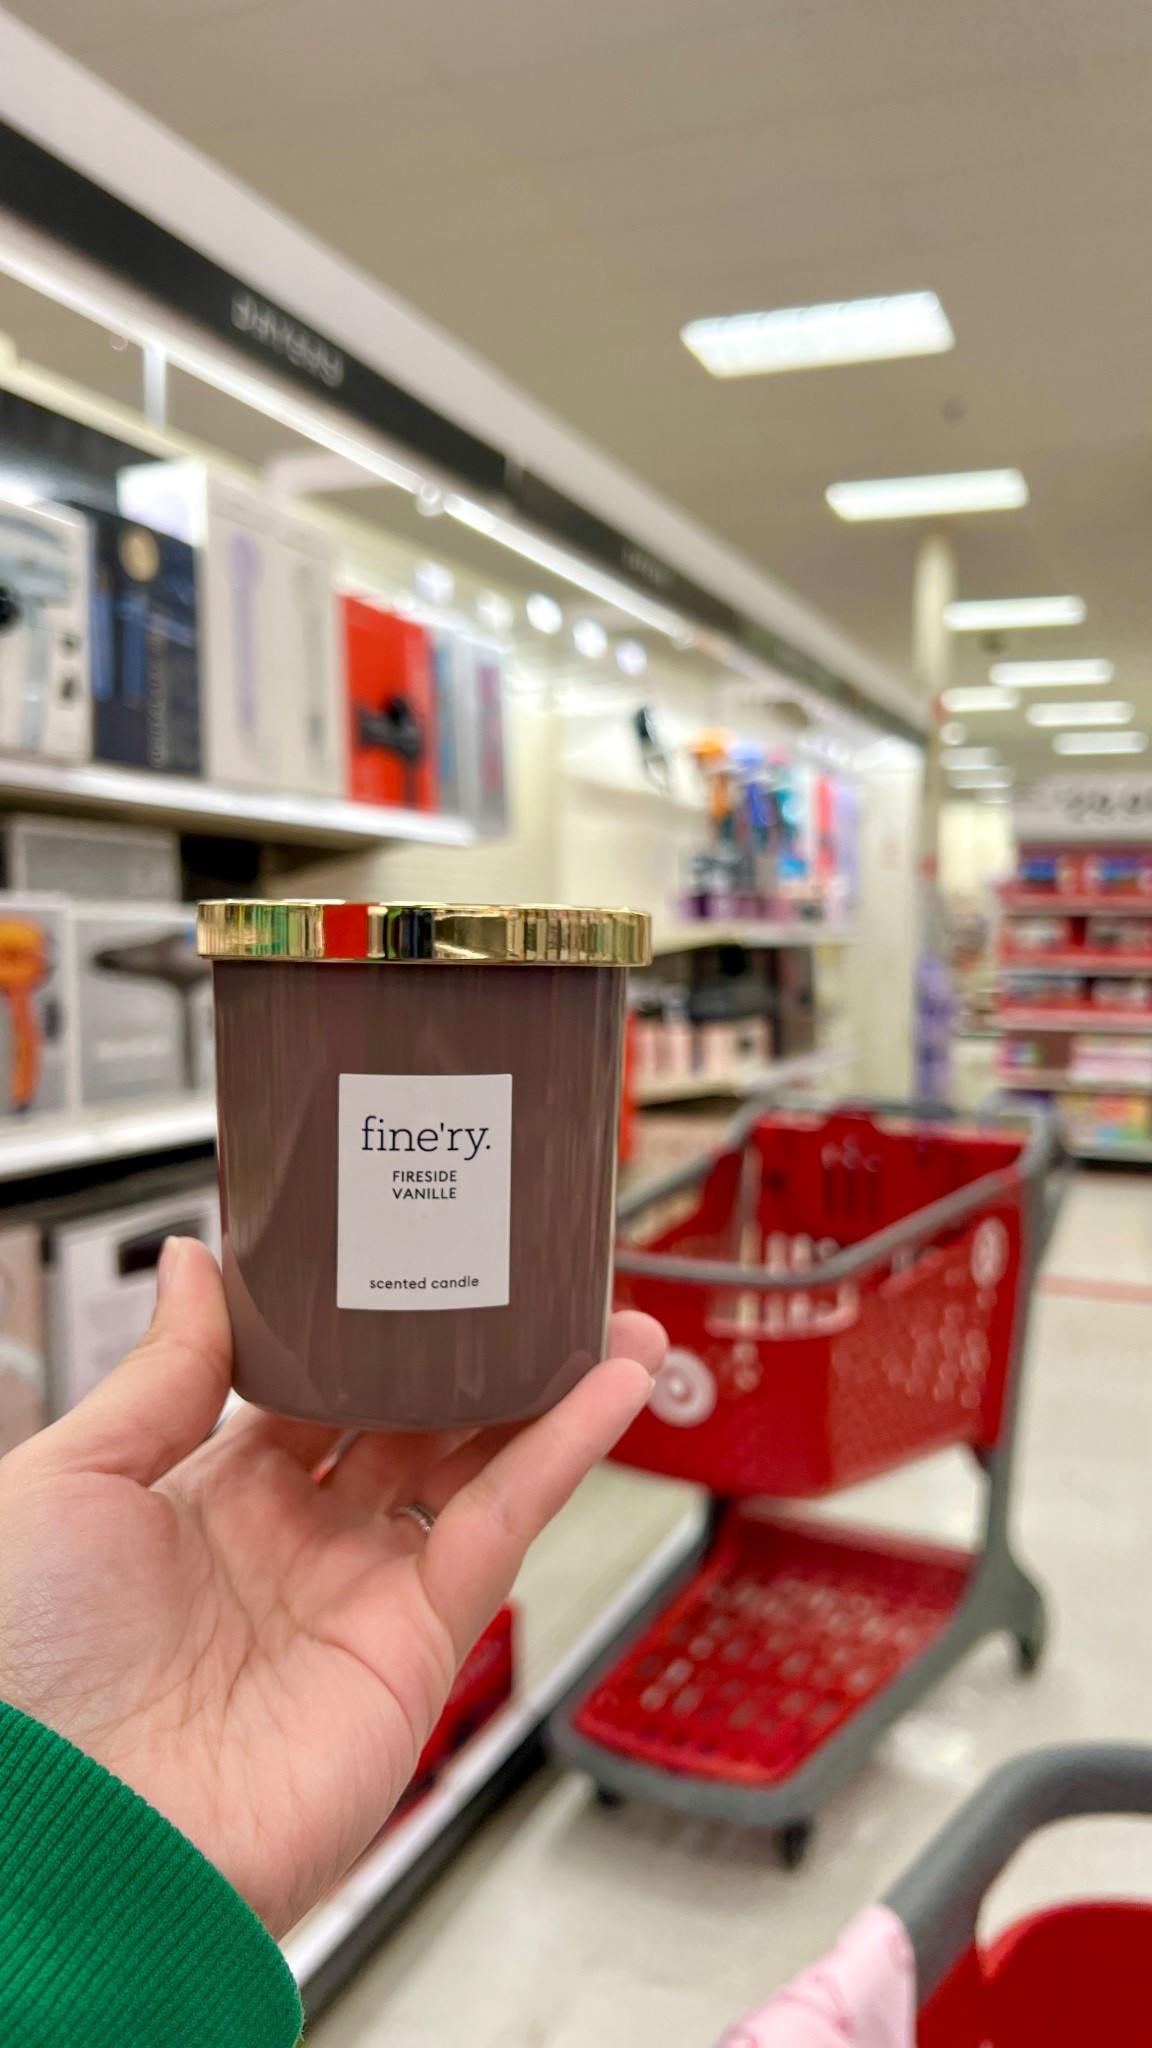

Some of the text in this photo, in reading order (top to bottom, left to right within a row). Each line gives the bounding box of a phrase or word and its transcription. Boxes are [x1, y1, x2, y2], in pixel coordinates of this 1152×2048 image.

[361, 1115, 491, 1161] fine'ry.
[392, 1170, 457, 1183] FIRESIDE
[392, 1187, 457, 1200] VANILLE
[369, 1275, 480, 1290] scented candle
